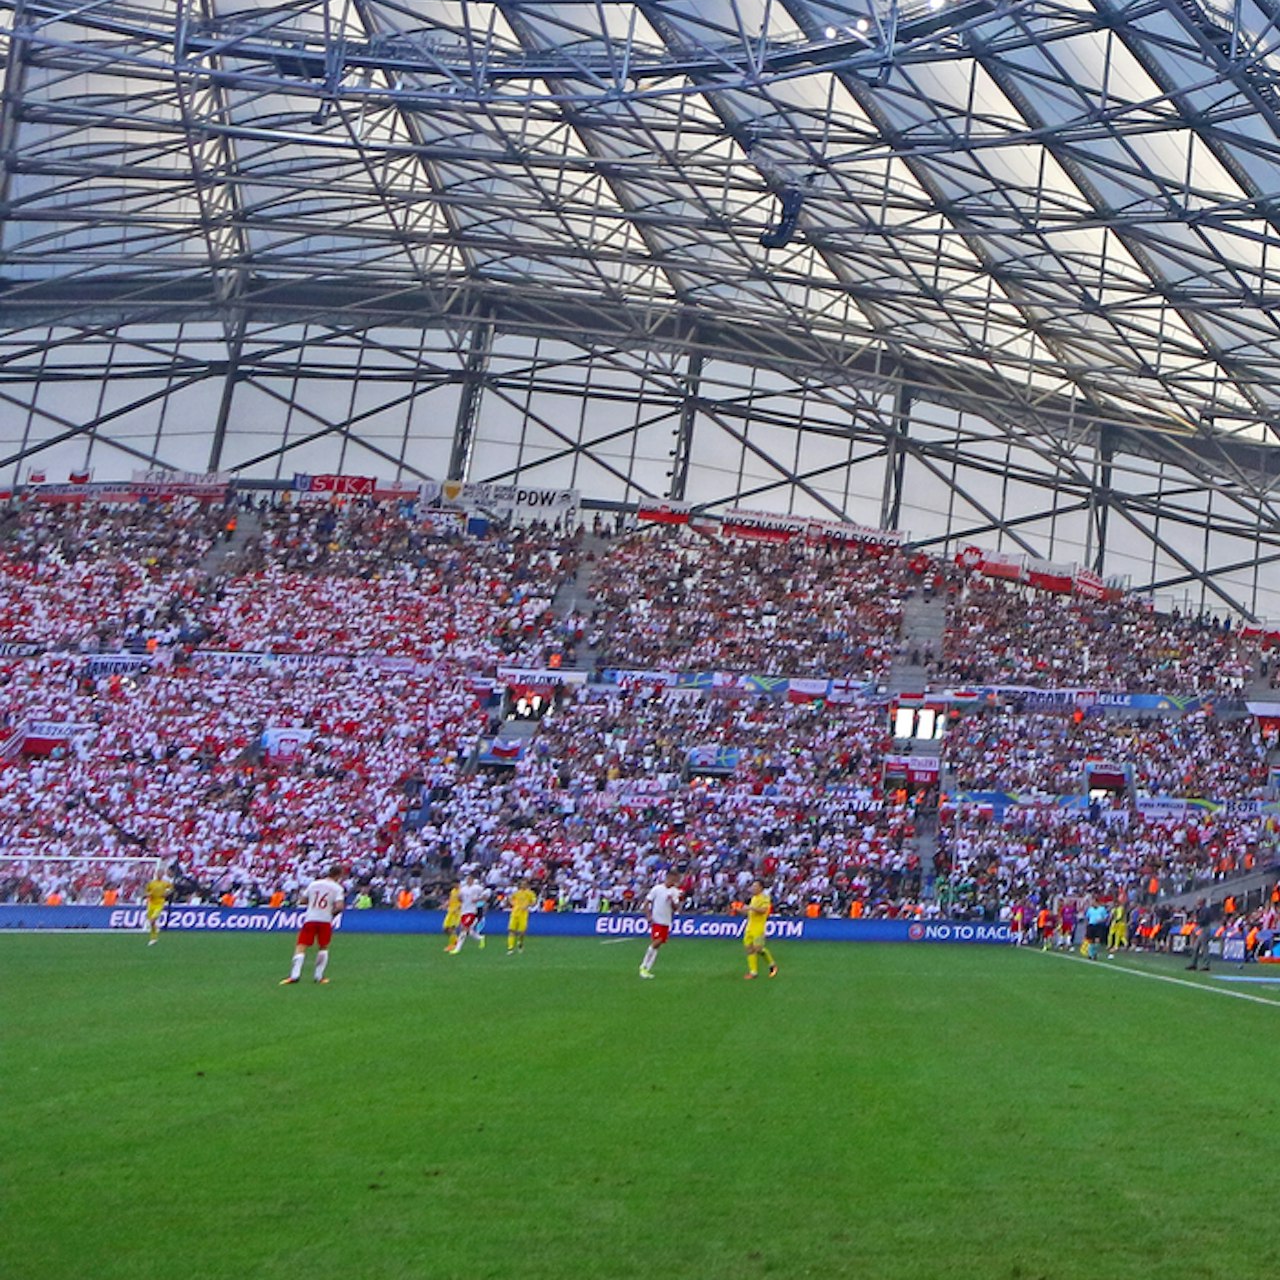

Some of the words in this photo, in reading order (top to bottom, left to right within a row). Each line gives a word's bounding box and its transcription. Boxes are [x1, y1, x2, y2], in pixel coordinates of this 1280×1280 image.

[312, 890, 328, 910] 16
[109, 909, 343, 930] EUO2016.com/MOM
[595, 917, 804, 937] EURO16.com/OTM
[925, 925, 951, 939] NO
[953, 925, 974, 939] TO
